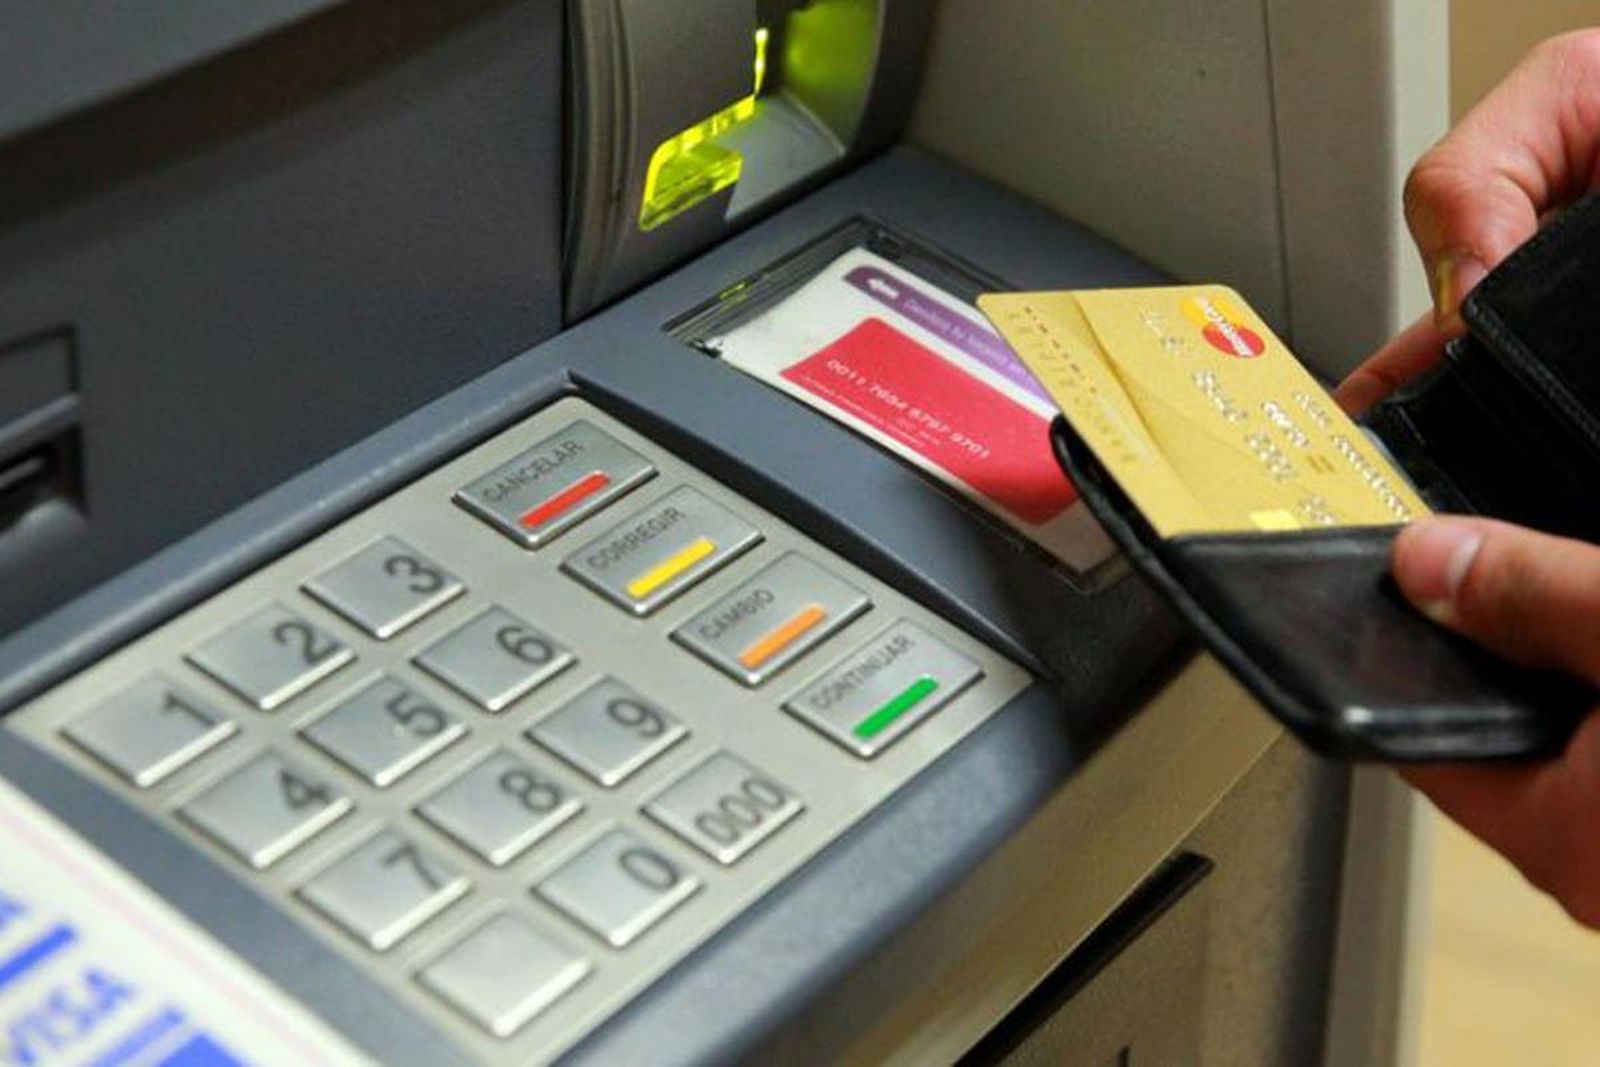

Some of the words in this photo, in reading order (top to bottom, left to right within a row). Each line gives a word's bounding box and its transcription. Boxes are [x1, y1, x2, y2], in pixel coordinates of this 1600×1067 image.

[482, 440, 584, 503] CANCELAR
[587, 506, 686, 573] CORREGIR
[382, 554, 443, 594] 3
[700, 588, 775, 640] CAMBIO
[271, 619, 342, 664] 2
[496, 625, 554, 665] 6
[810, 634, 916, 709] CONTINUAR
[163, 690, 218, 727] 1
[384, 691, 446, 738] 5
[606, 698, 666, 739] 9
[279, 768, 330, 809] 4
[499, 767, 563, 812] 8
[695, 776, 787, 846] 000
[382, 843, 441, 890] 7
[619, 847, 680, 891] 0
